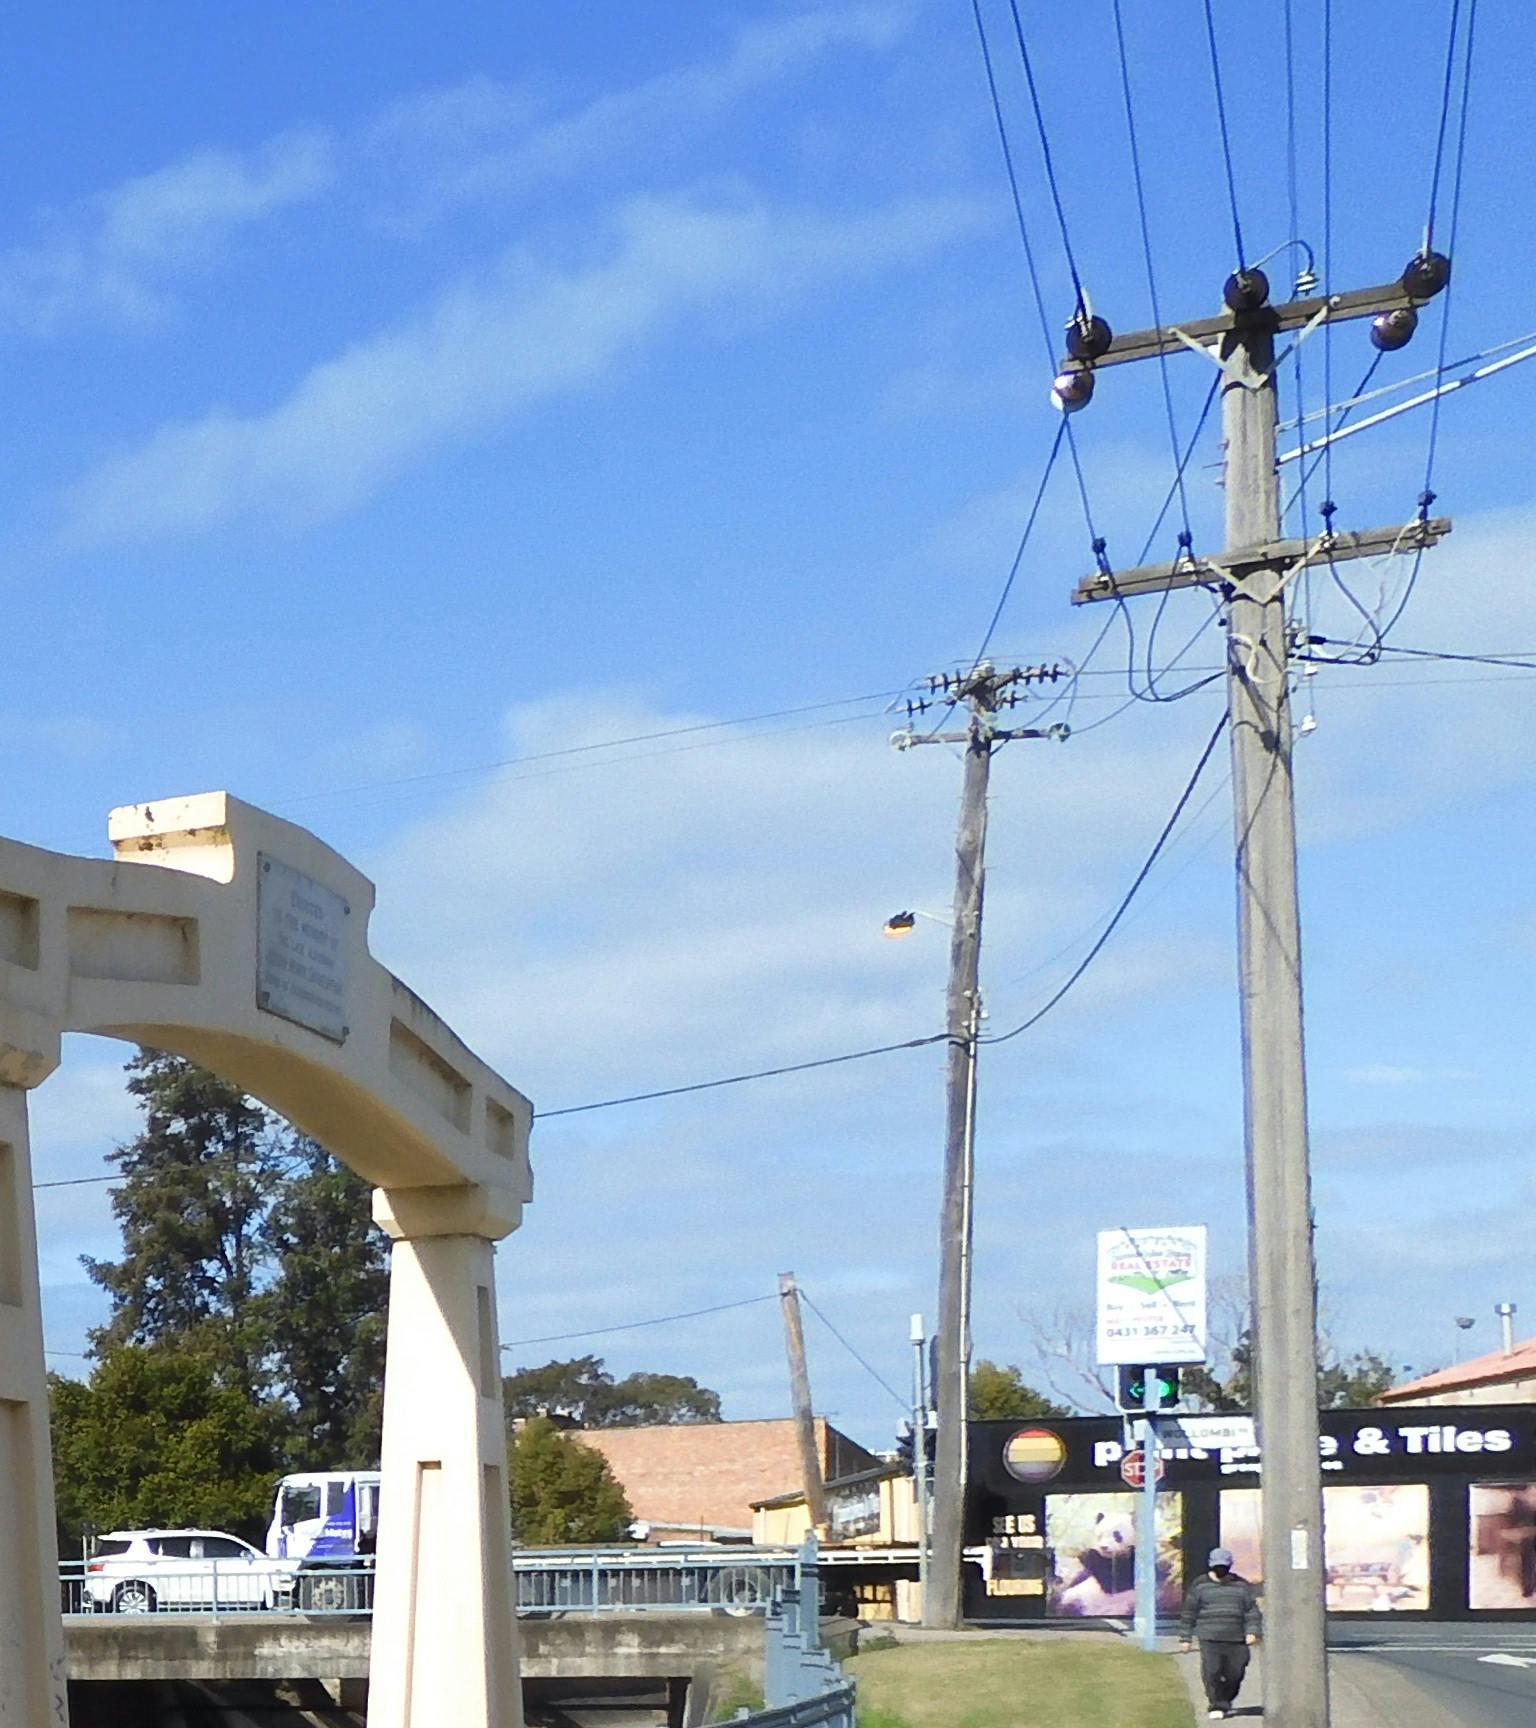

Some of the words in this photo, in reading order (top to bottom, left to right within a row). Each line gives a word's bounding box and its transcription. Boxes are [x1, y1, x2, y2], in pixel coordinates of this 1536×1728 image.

[1111, 1262, 1142, 1270] REAL
[1145, 1259, 1192, 1269] ESTATE
[1352, 1427, 1390, 1455] &
[1397, 1426, 1513, 1454] Tiles
